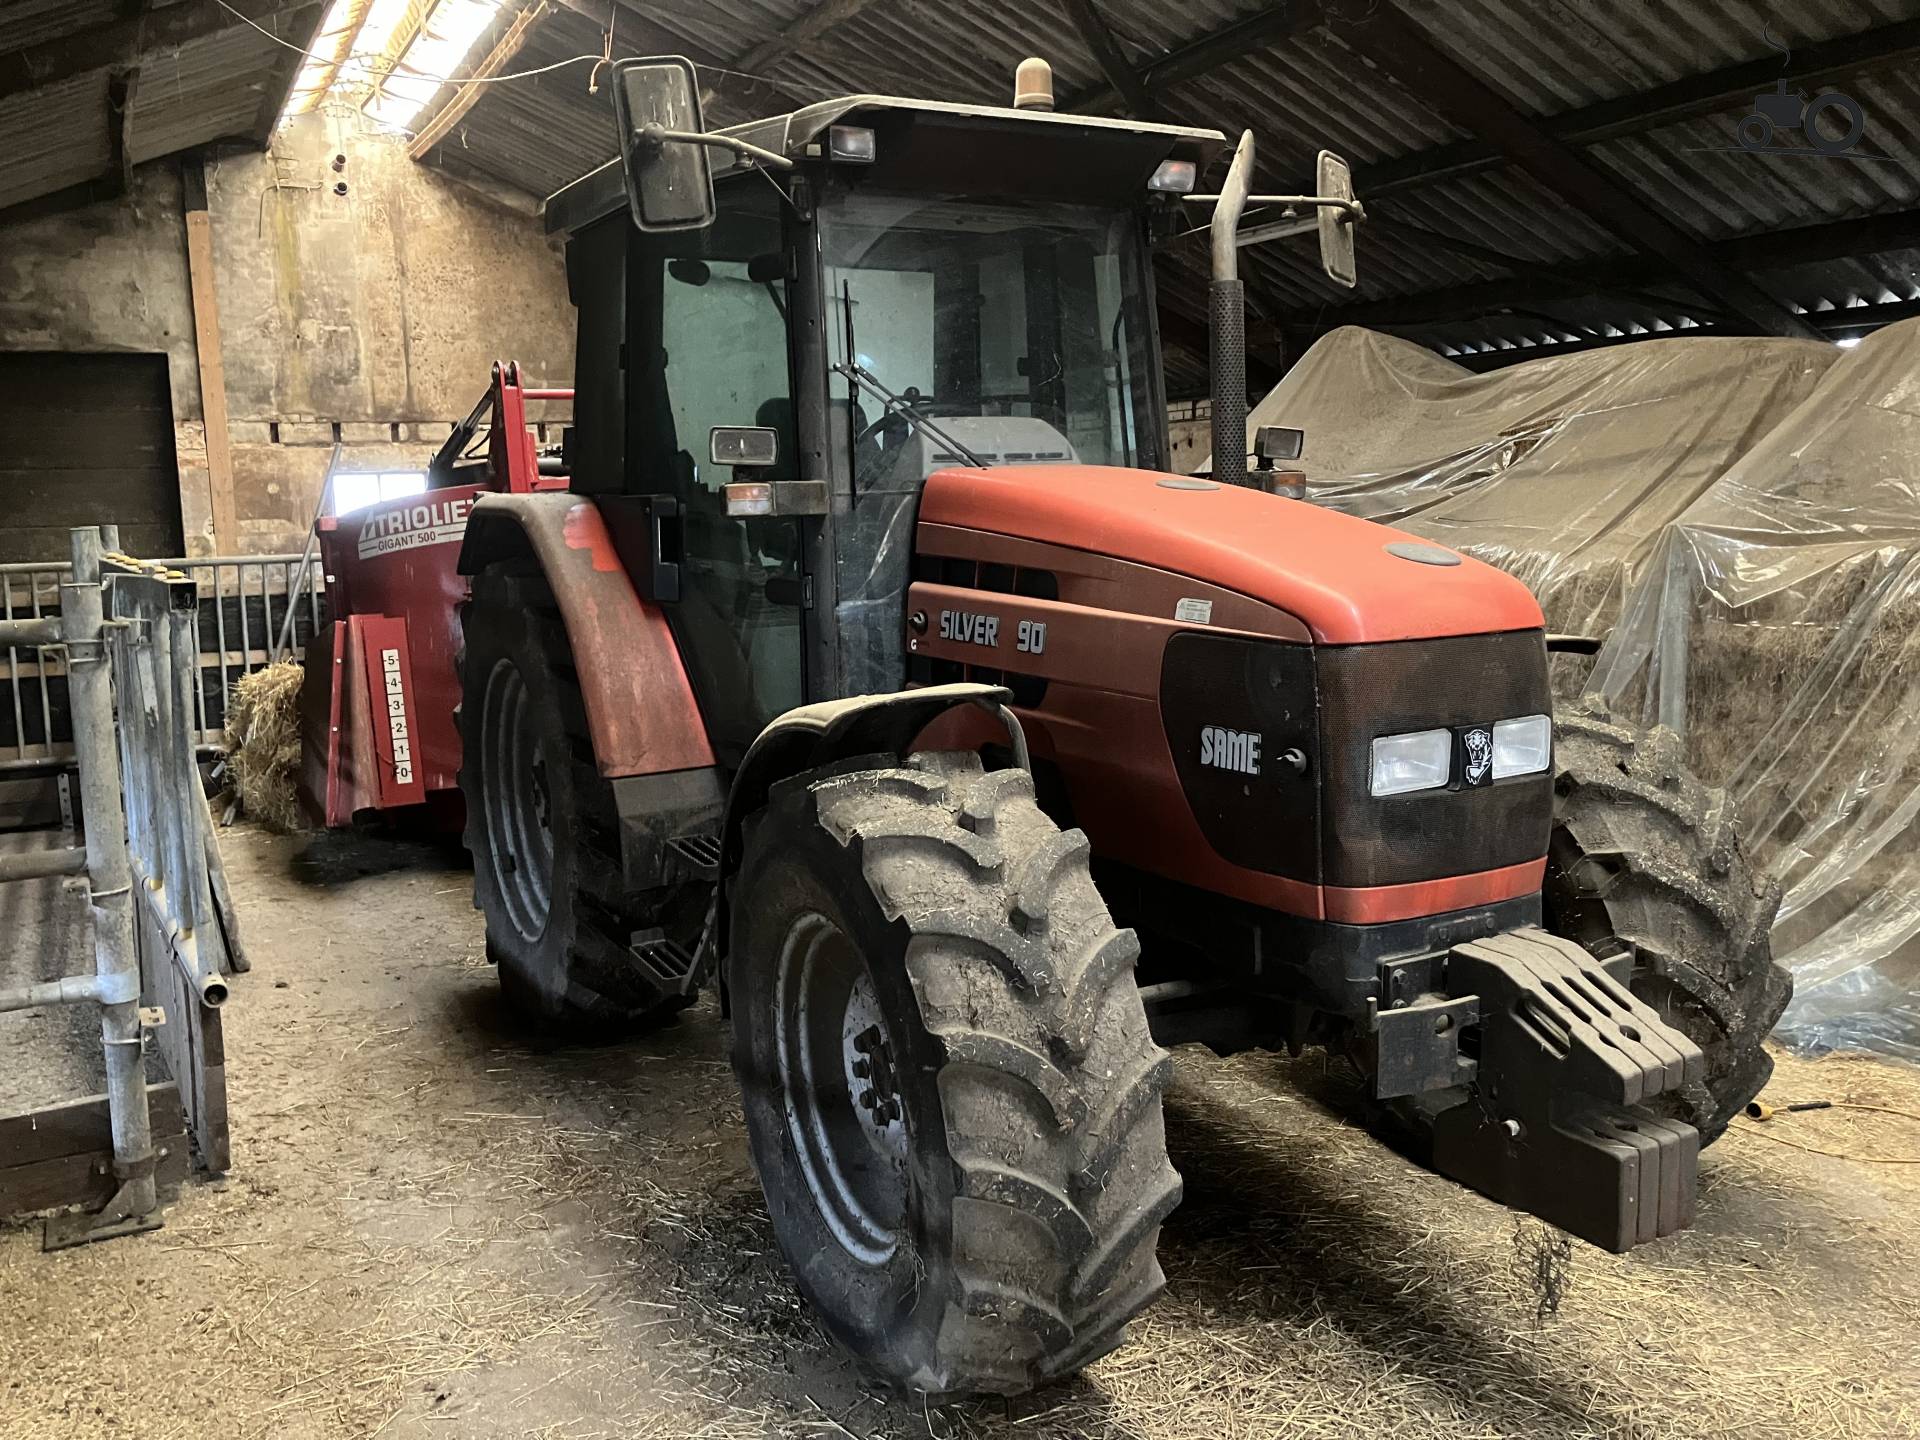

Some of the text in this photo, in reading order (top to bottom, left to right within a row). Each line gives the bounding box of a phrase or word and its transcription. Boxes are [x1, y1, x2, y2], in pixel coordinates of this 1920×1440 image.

[375, 499, 474, 537] TRIOLIE
[378, 531, 436, 551] GIGANT 500
[940, 610, 1047, 654] SILVER 90
[387, 655, 395, 665] 5
[390, 678, 398, 687] 4
[392, 700, 401, 710] 3
[395, 723, 404, 733] 2
[398, 745, 404, 755] 1
[1200, 726, 1261, 776] SAME
[400, 767, 408, 778] 0
